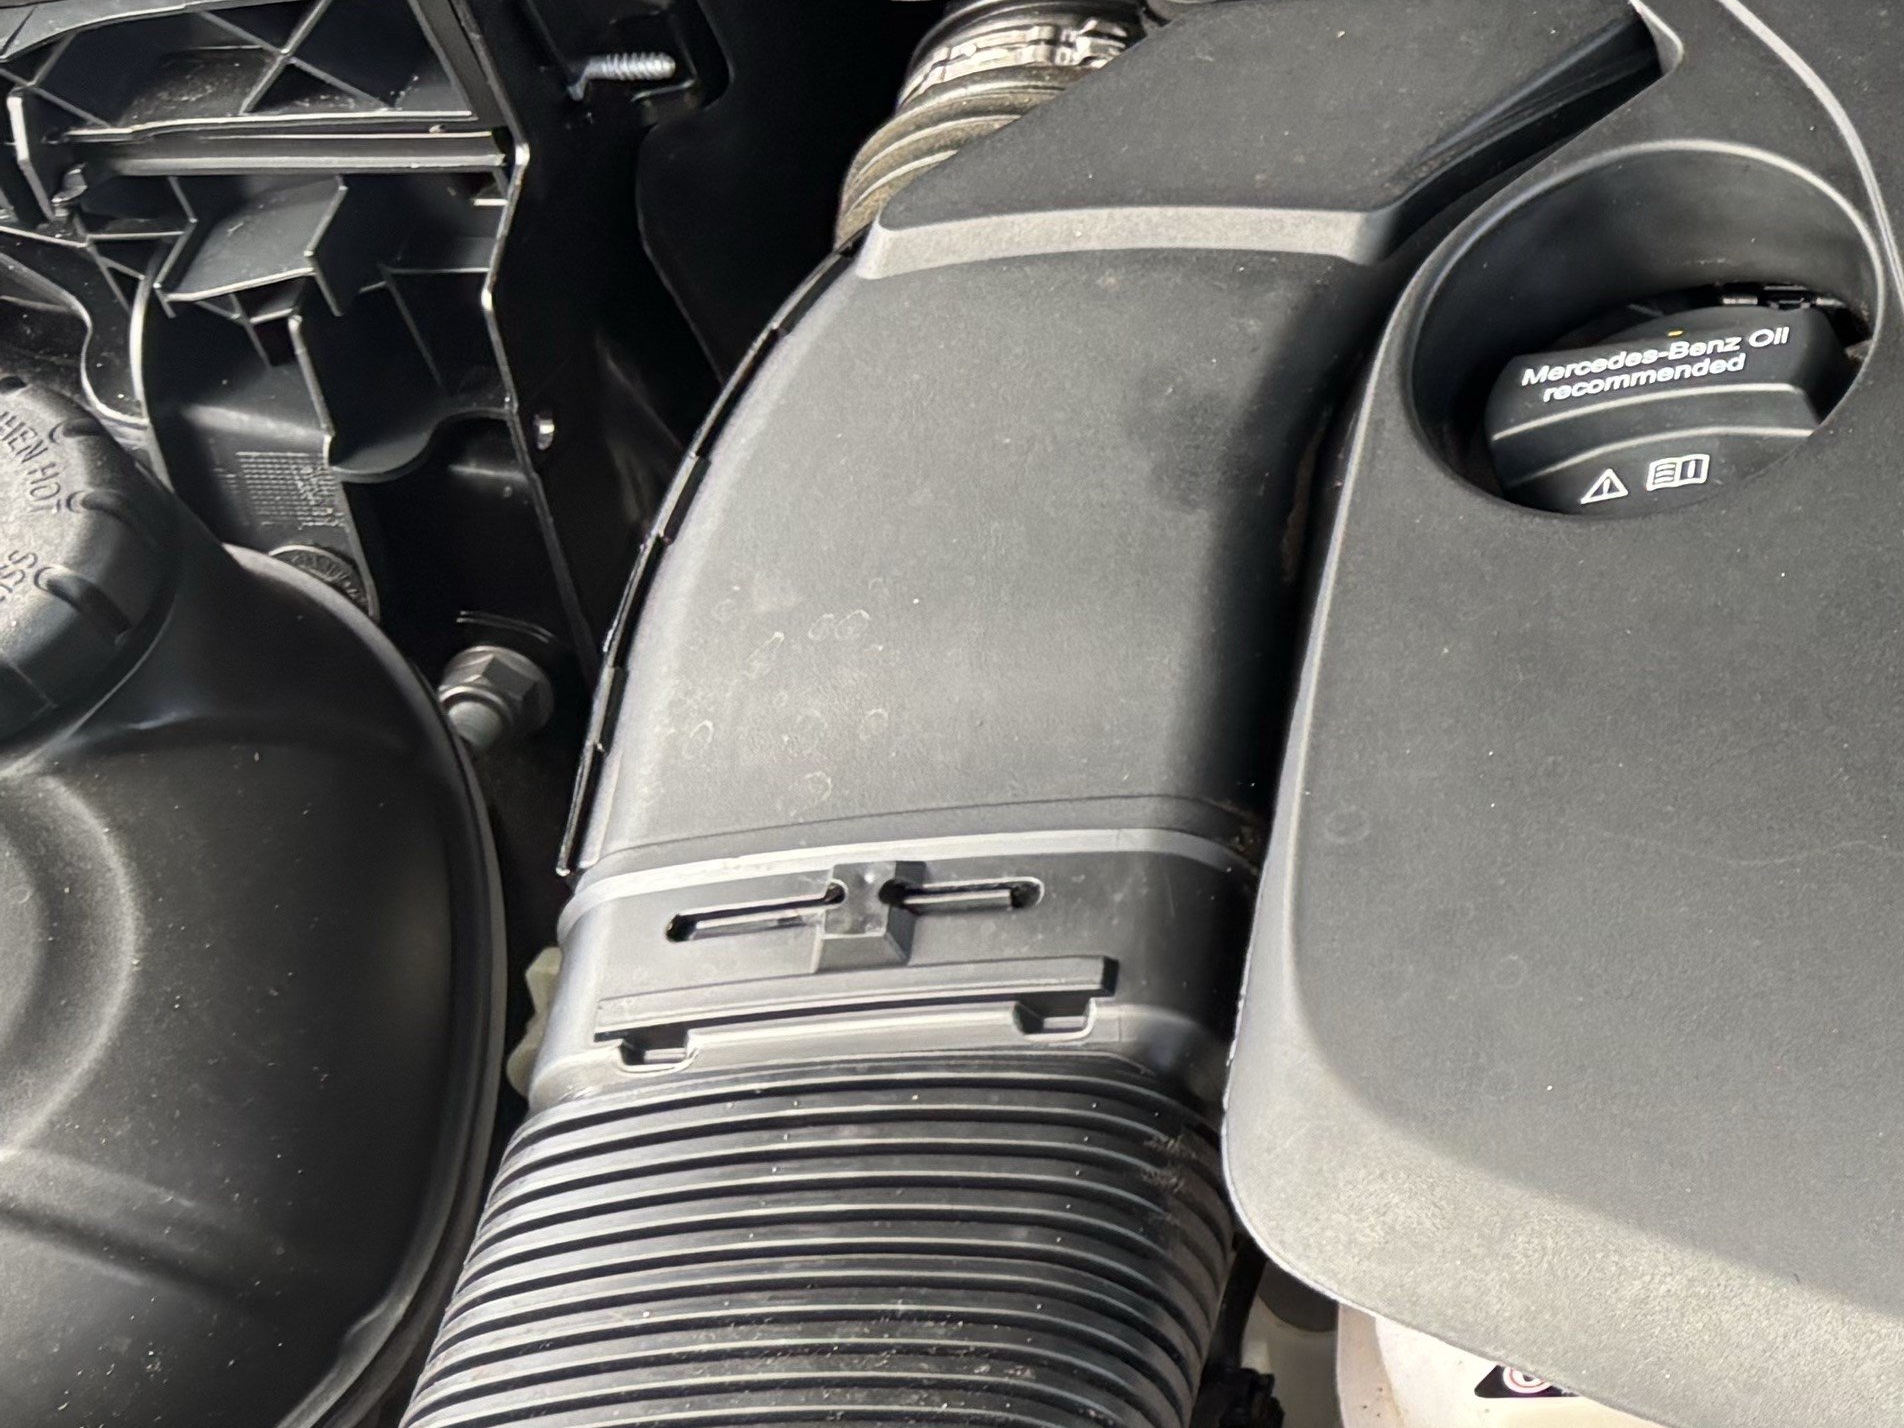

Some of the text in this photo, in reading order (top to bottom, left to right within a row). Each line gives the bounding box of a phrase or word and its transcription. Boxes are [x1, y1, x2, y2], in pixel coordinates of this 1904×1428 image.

[1521, 326, 1790, 386] Mercedes-Benz Oil
[1543, 353, 1746, 403] recommended
[0, 411, 62, 514] HEN HOT
